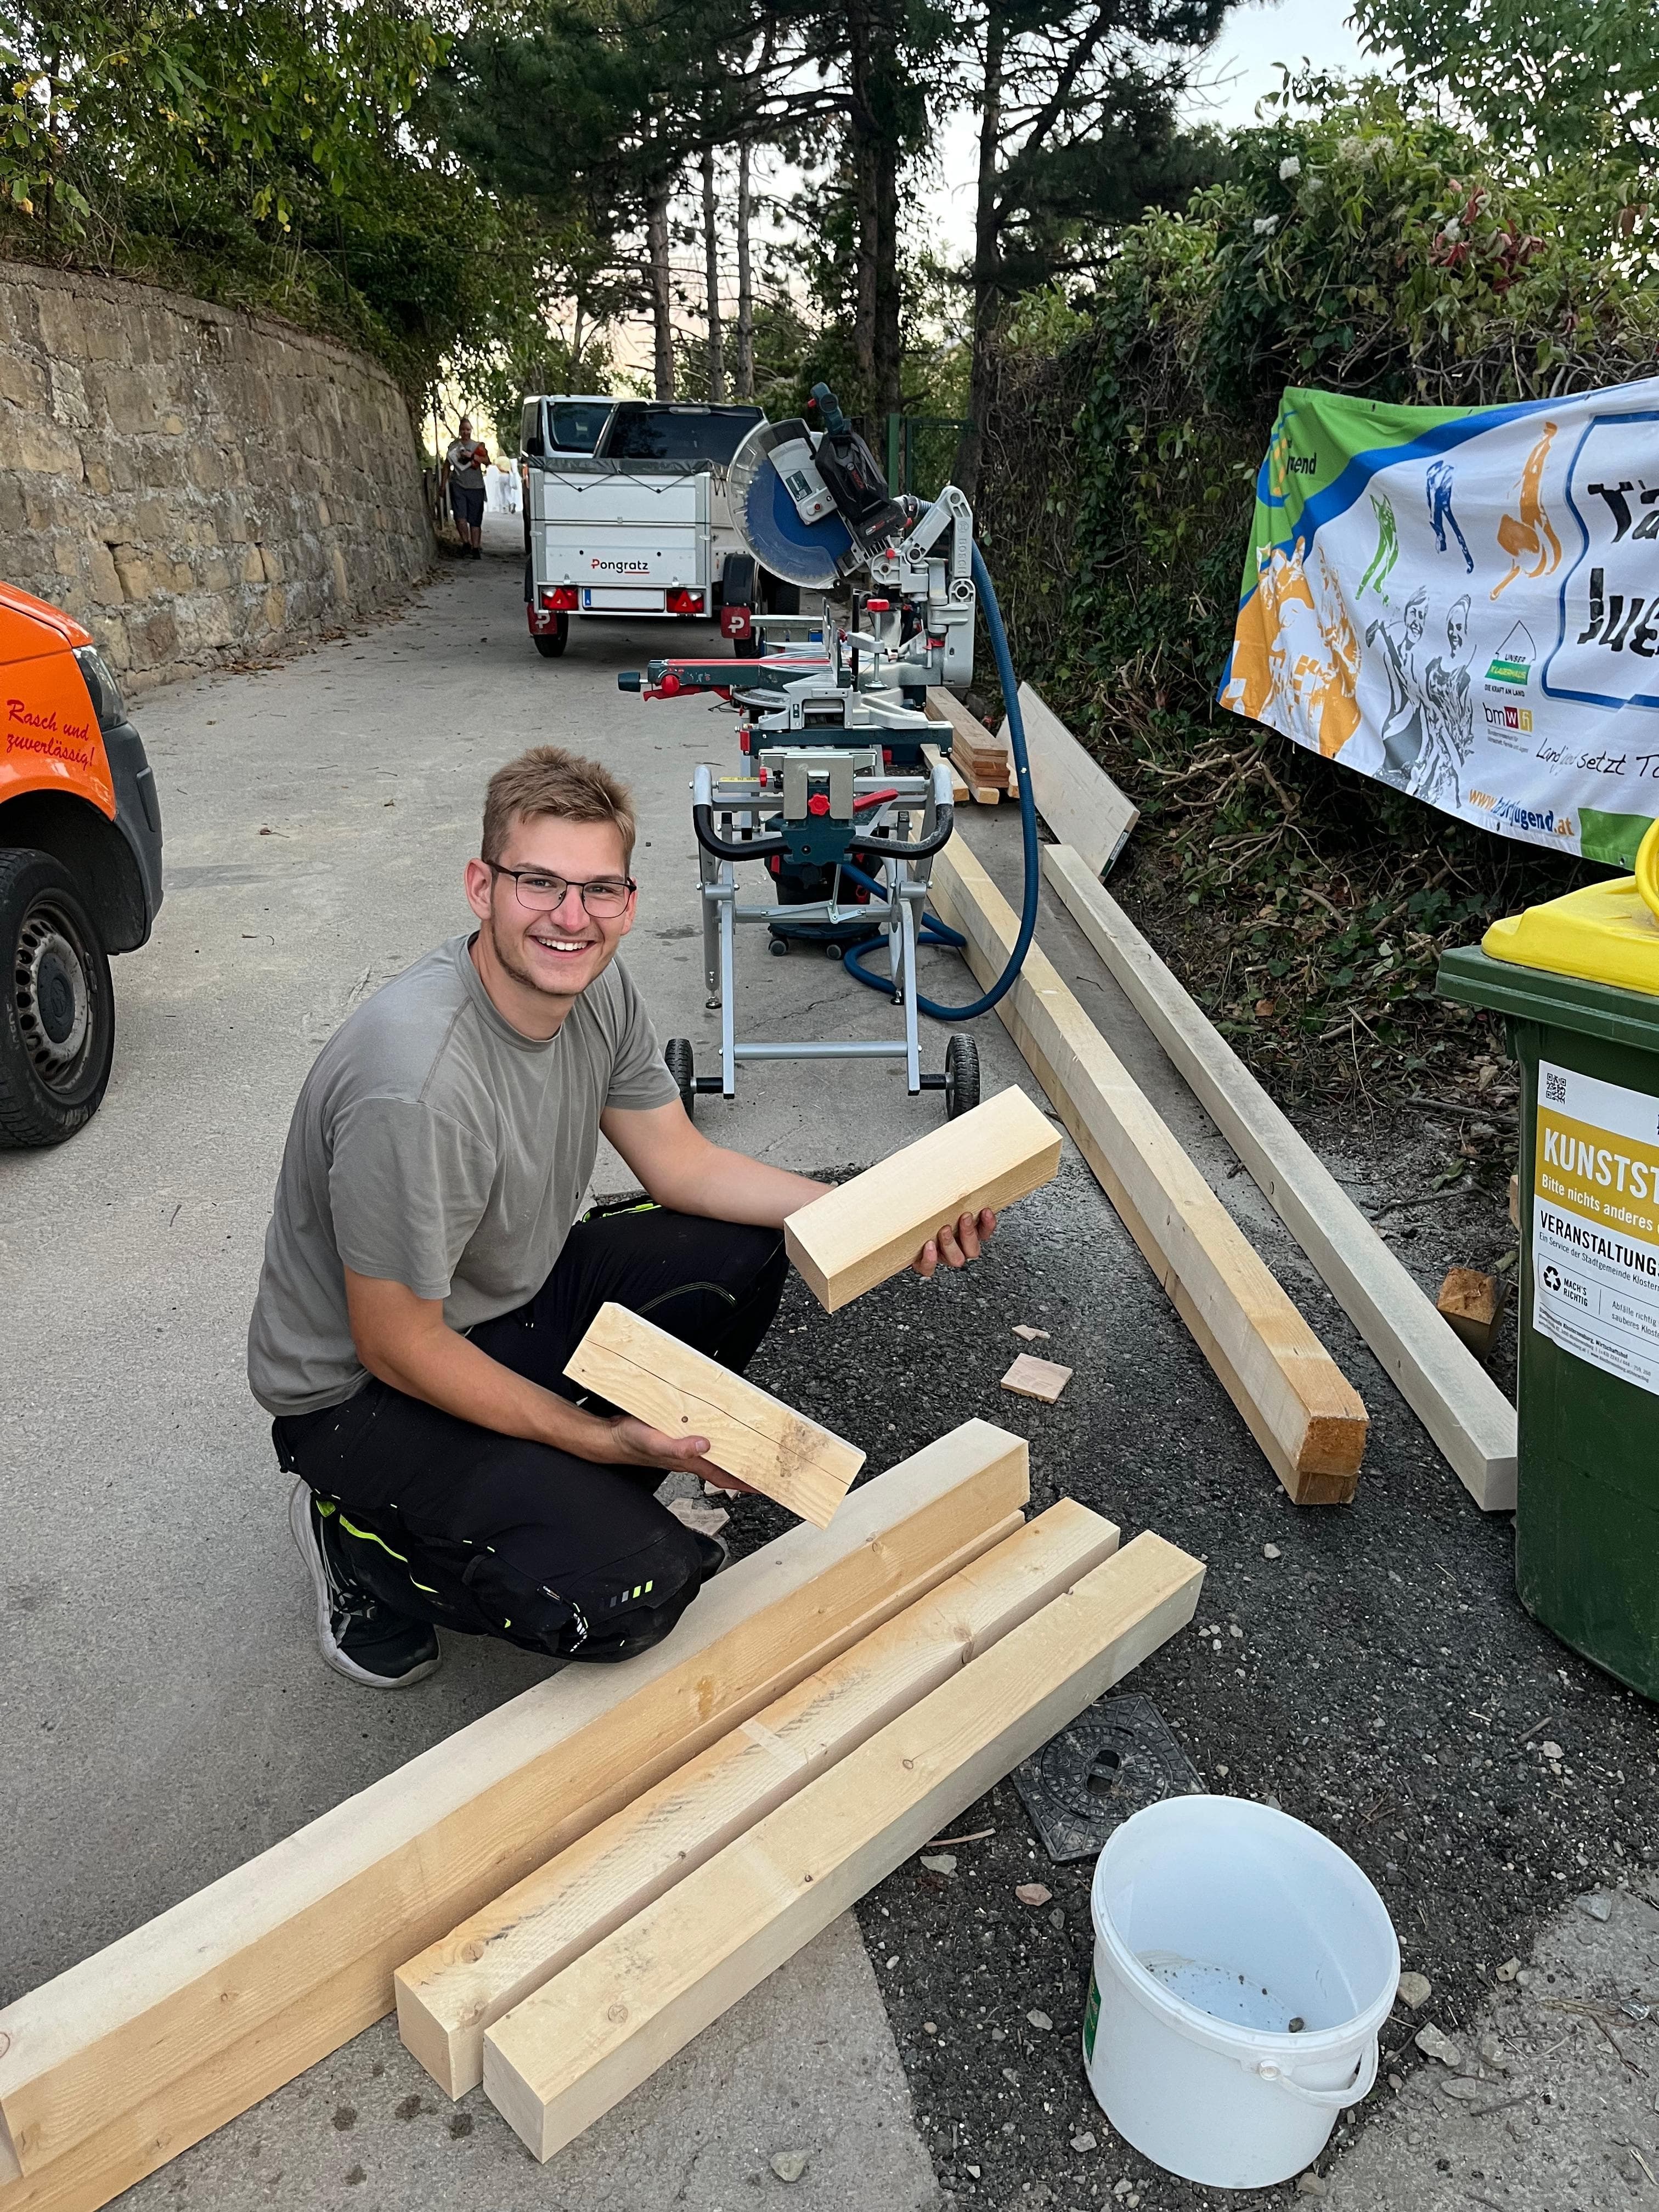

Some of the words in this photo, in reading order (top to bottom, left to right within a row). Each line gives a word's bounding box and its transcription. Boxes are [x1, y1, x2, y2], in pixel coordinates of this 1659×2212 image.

[591, 558, 650, 574] Pongratz
[957, 539, 967, 574] BOSCH
[7, 699, 58, 732] Rasch
[63, 724, 89, 741] und
[7, 733, 95, 771] zuverlässig!
[1577, 751, 1626, 775] setzt
[1542, 1173, 1565, 1196] Bitte
[1567, 1188, 1600, 1211] nichts
[1604, 1203, 1653, 1231] anderes
[1539, 1232, 1548, 1243] Ein
[1549, 1236, 1570, 1254] Service
[1571, 1249, 1581, 1259] der
[1582, 1252, 1631, 1281] Stadtgemeinde
[1541, 1210, 1659, 1277] VERANSTALTUNG
[1564, 1278, 1587, 1296] MACH'S
[1564, 1288, 1588, 1307] RICHTIG
[1612, 1301, 1634, 1317] Abfälle
[1635, 1312, 1657, 1328] richtig
[1612, 1313, 1639, 1330] sauberes
